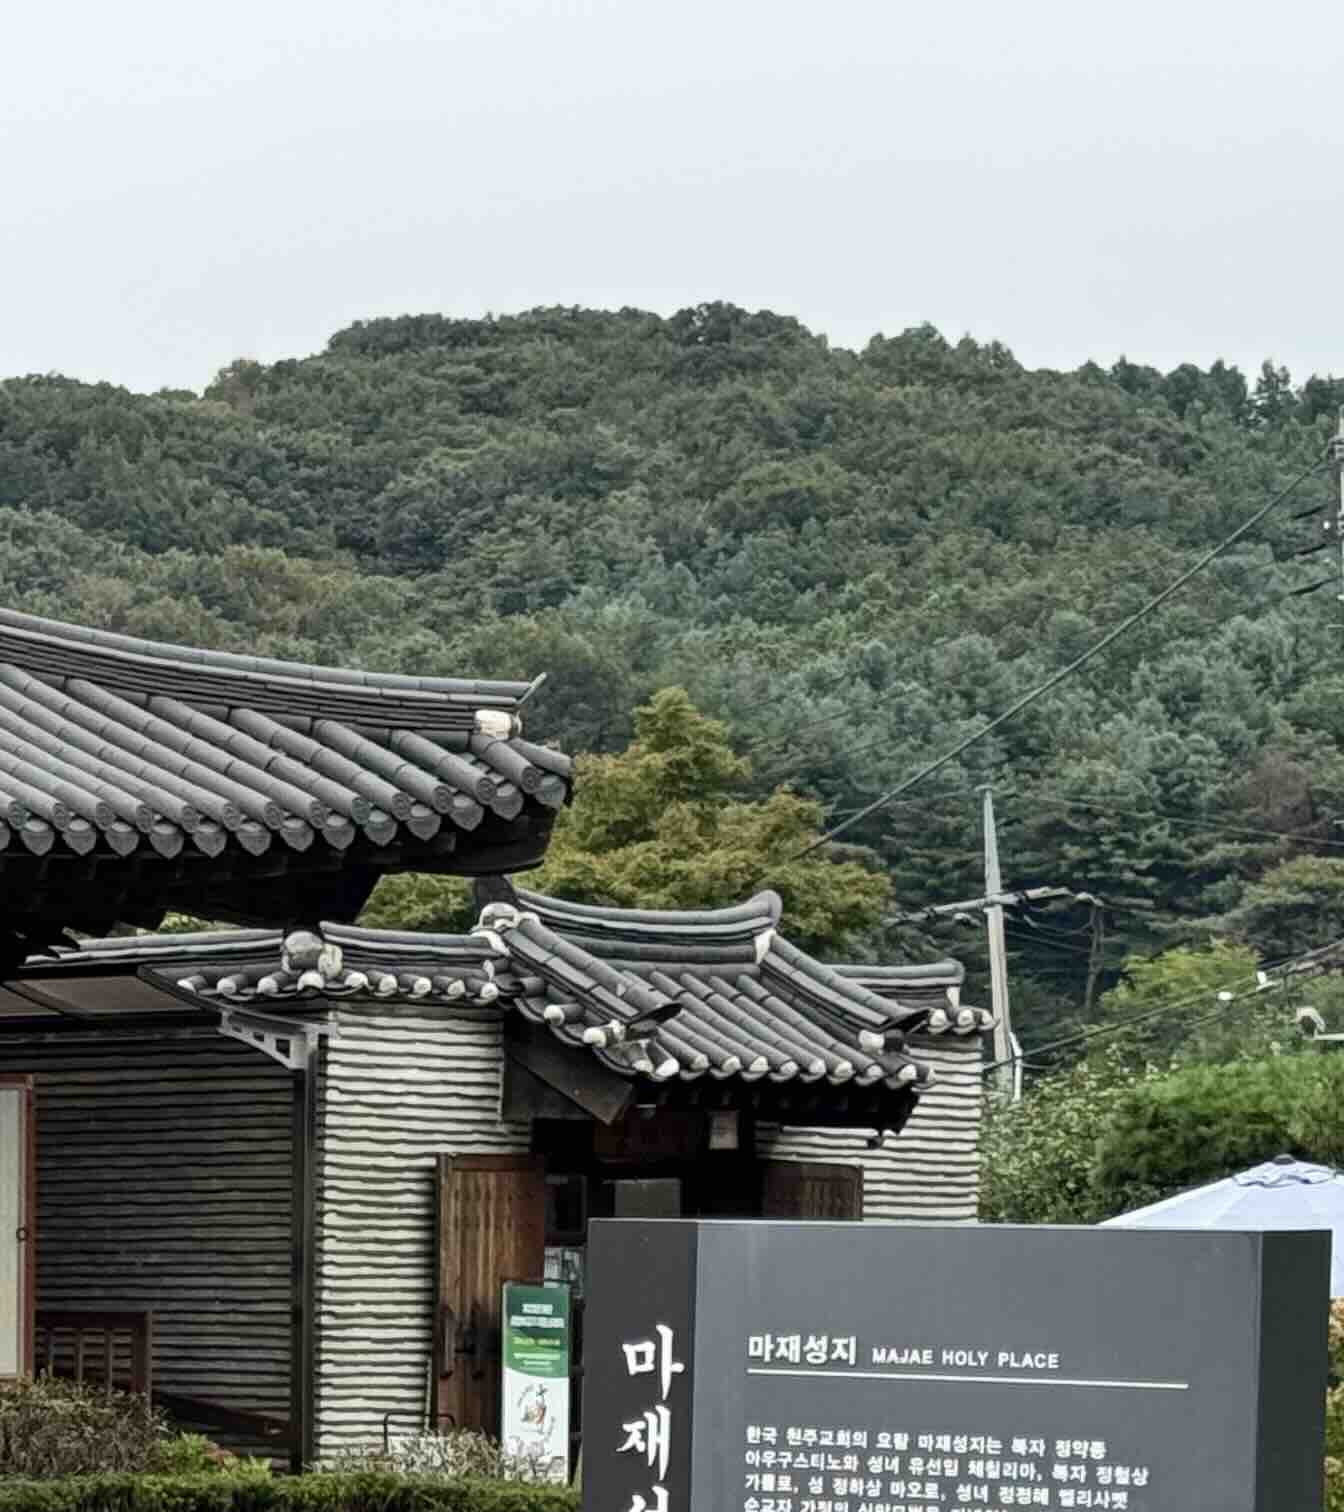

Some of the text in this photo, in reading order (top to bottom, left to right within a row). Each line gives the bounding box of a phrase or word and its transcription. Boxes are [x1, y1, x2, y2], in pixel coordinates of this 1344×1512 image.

[749, 1334, 1059, 1368] 마재성지 MAJAE HOLY PLACE
[746, 1425, 1106, 1459] 한국 천주교회의 요람 마재성지는 복자 정약종
[744, 1449, 859, 1472] 아우구스티노와
[866, 1455, 899, 1474] 성녀
[1051, 1463, 1086, 1483] 복자
[807, 1475, 823, 1494] 성
[832, 1477, 882, 1497] 정하상
[955, 1483, 988, 1502] 성녀
